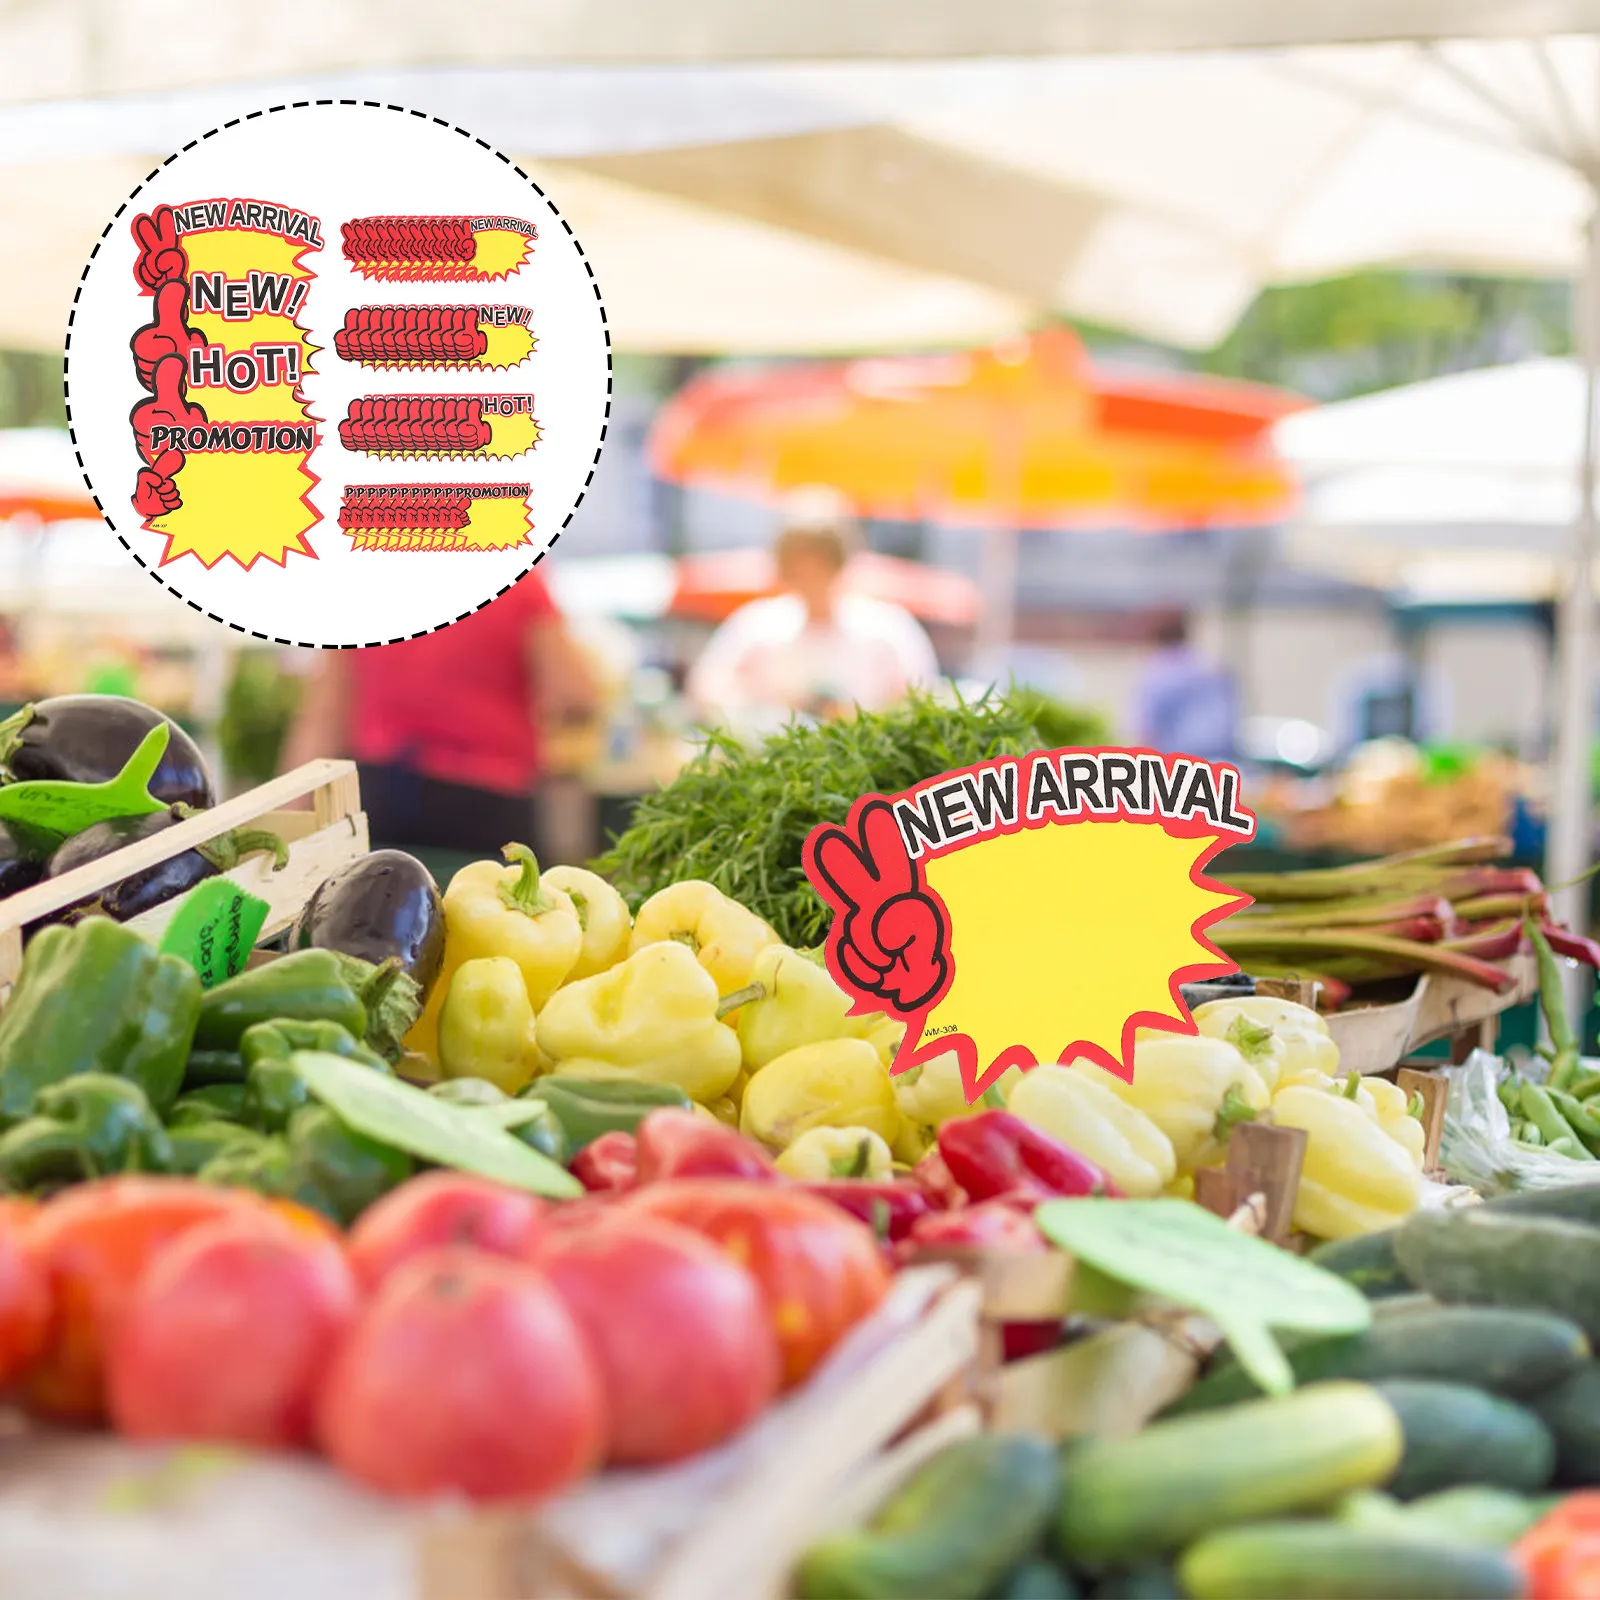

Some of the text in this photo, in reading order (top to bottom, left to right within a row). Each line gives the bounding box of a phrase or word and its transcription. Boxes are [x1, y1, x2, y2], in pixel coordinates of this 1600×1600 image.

[895, 757, 1253, 855] NEW ARRIVAL
[924, 1024, 958, 1036] WM-308
